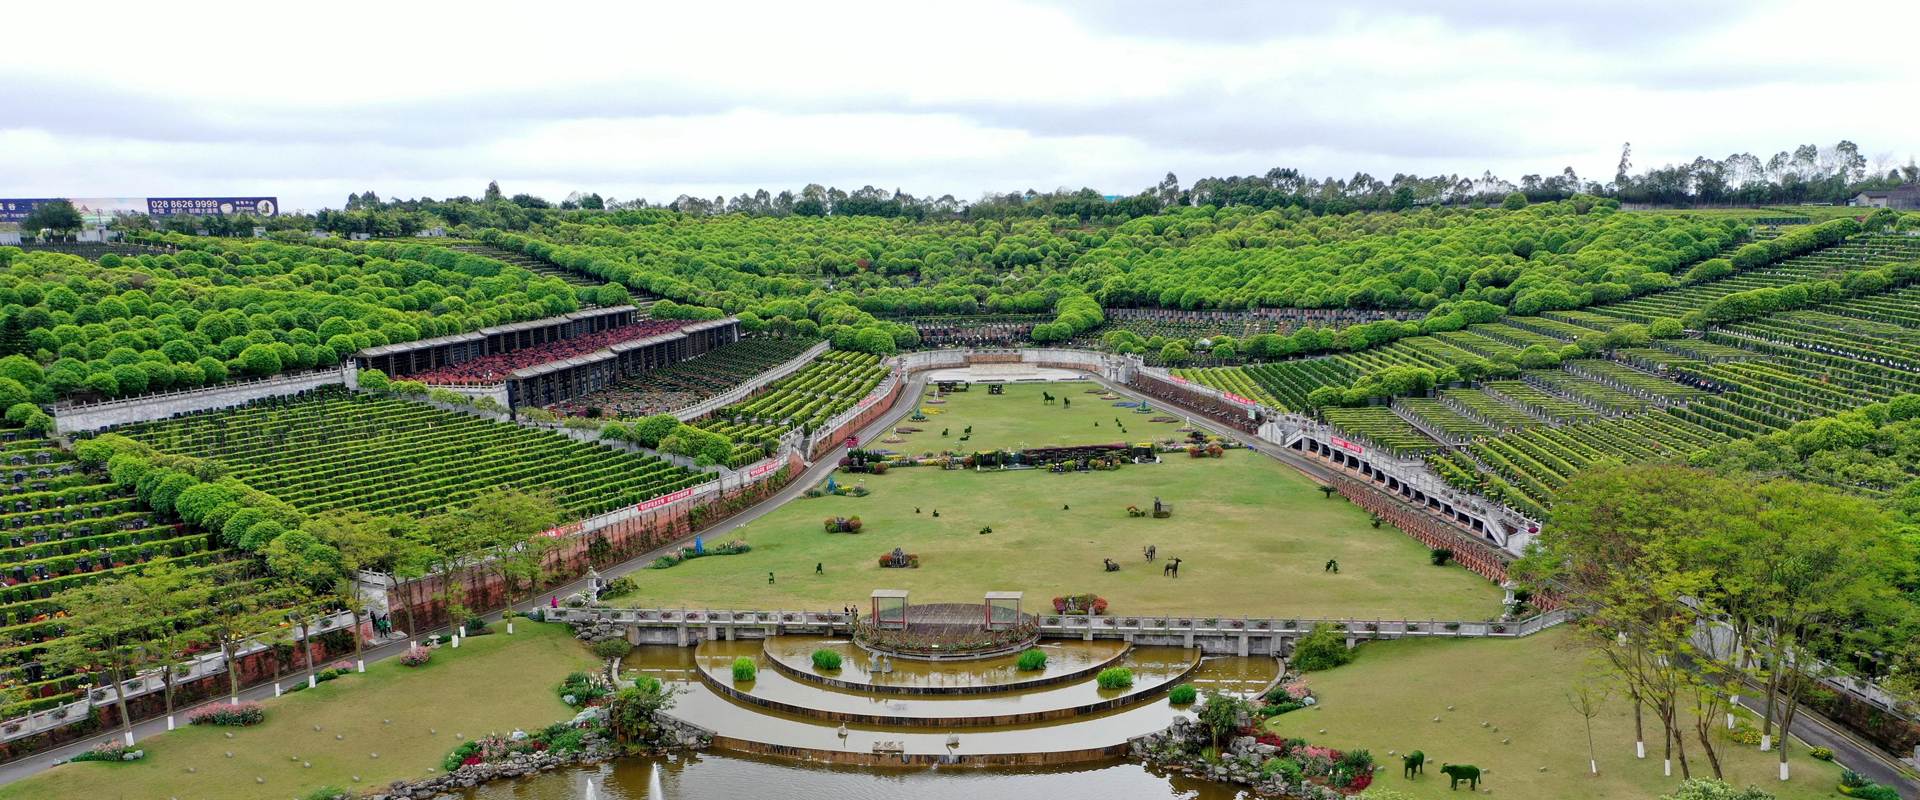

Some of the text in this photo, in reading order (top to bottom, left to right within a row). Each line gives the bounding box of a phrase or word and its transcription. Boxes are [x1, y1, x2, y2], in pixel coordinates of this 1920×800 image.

[151, 200, 218, 208] 028 8626 9999
